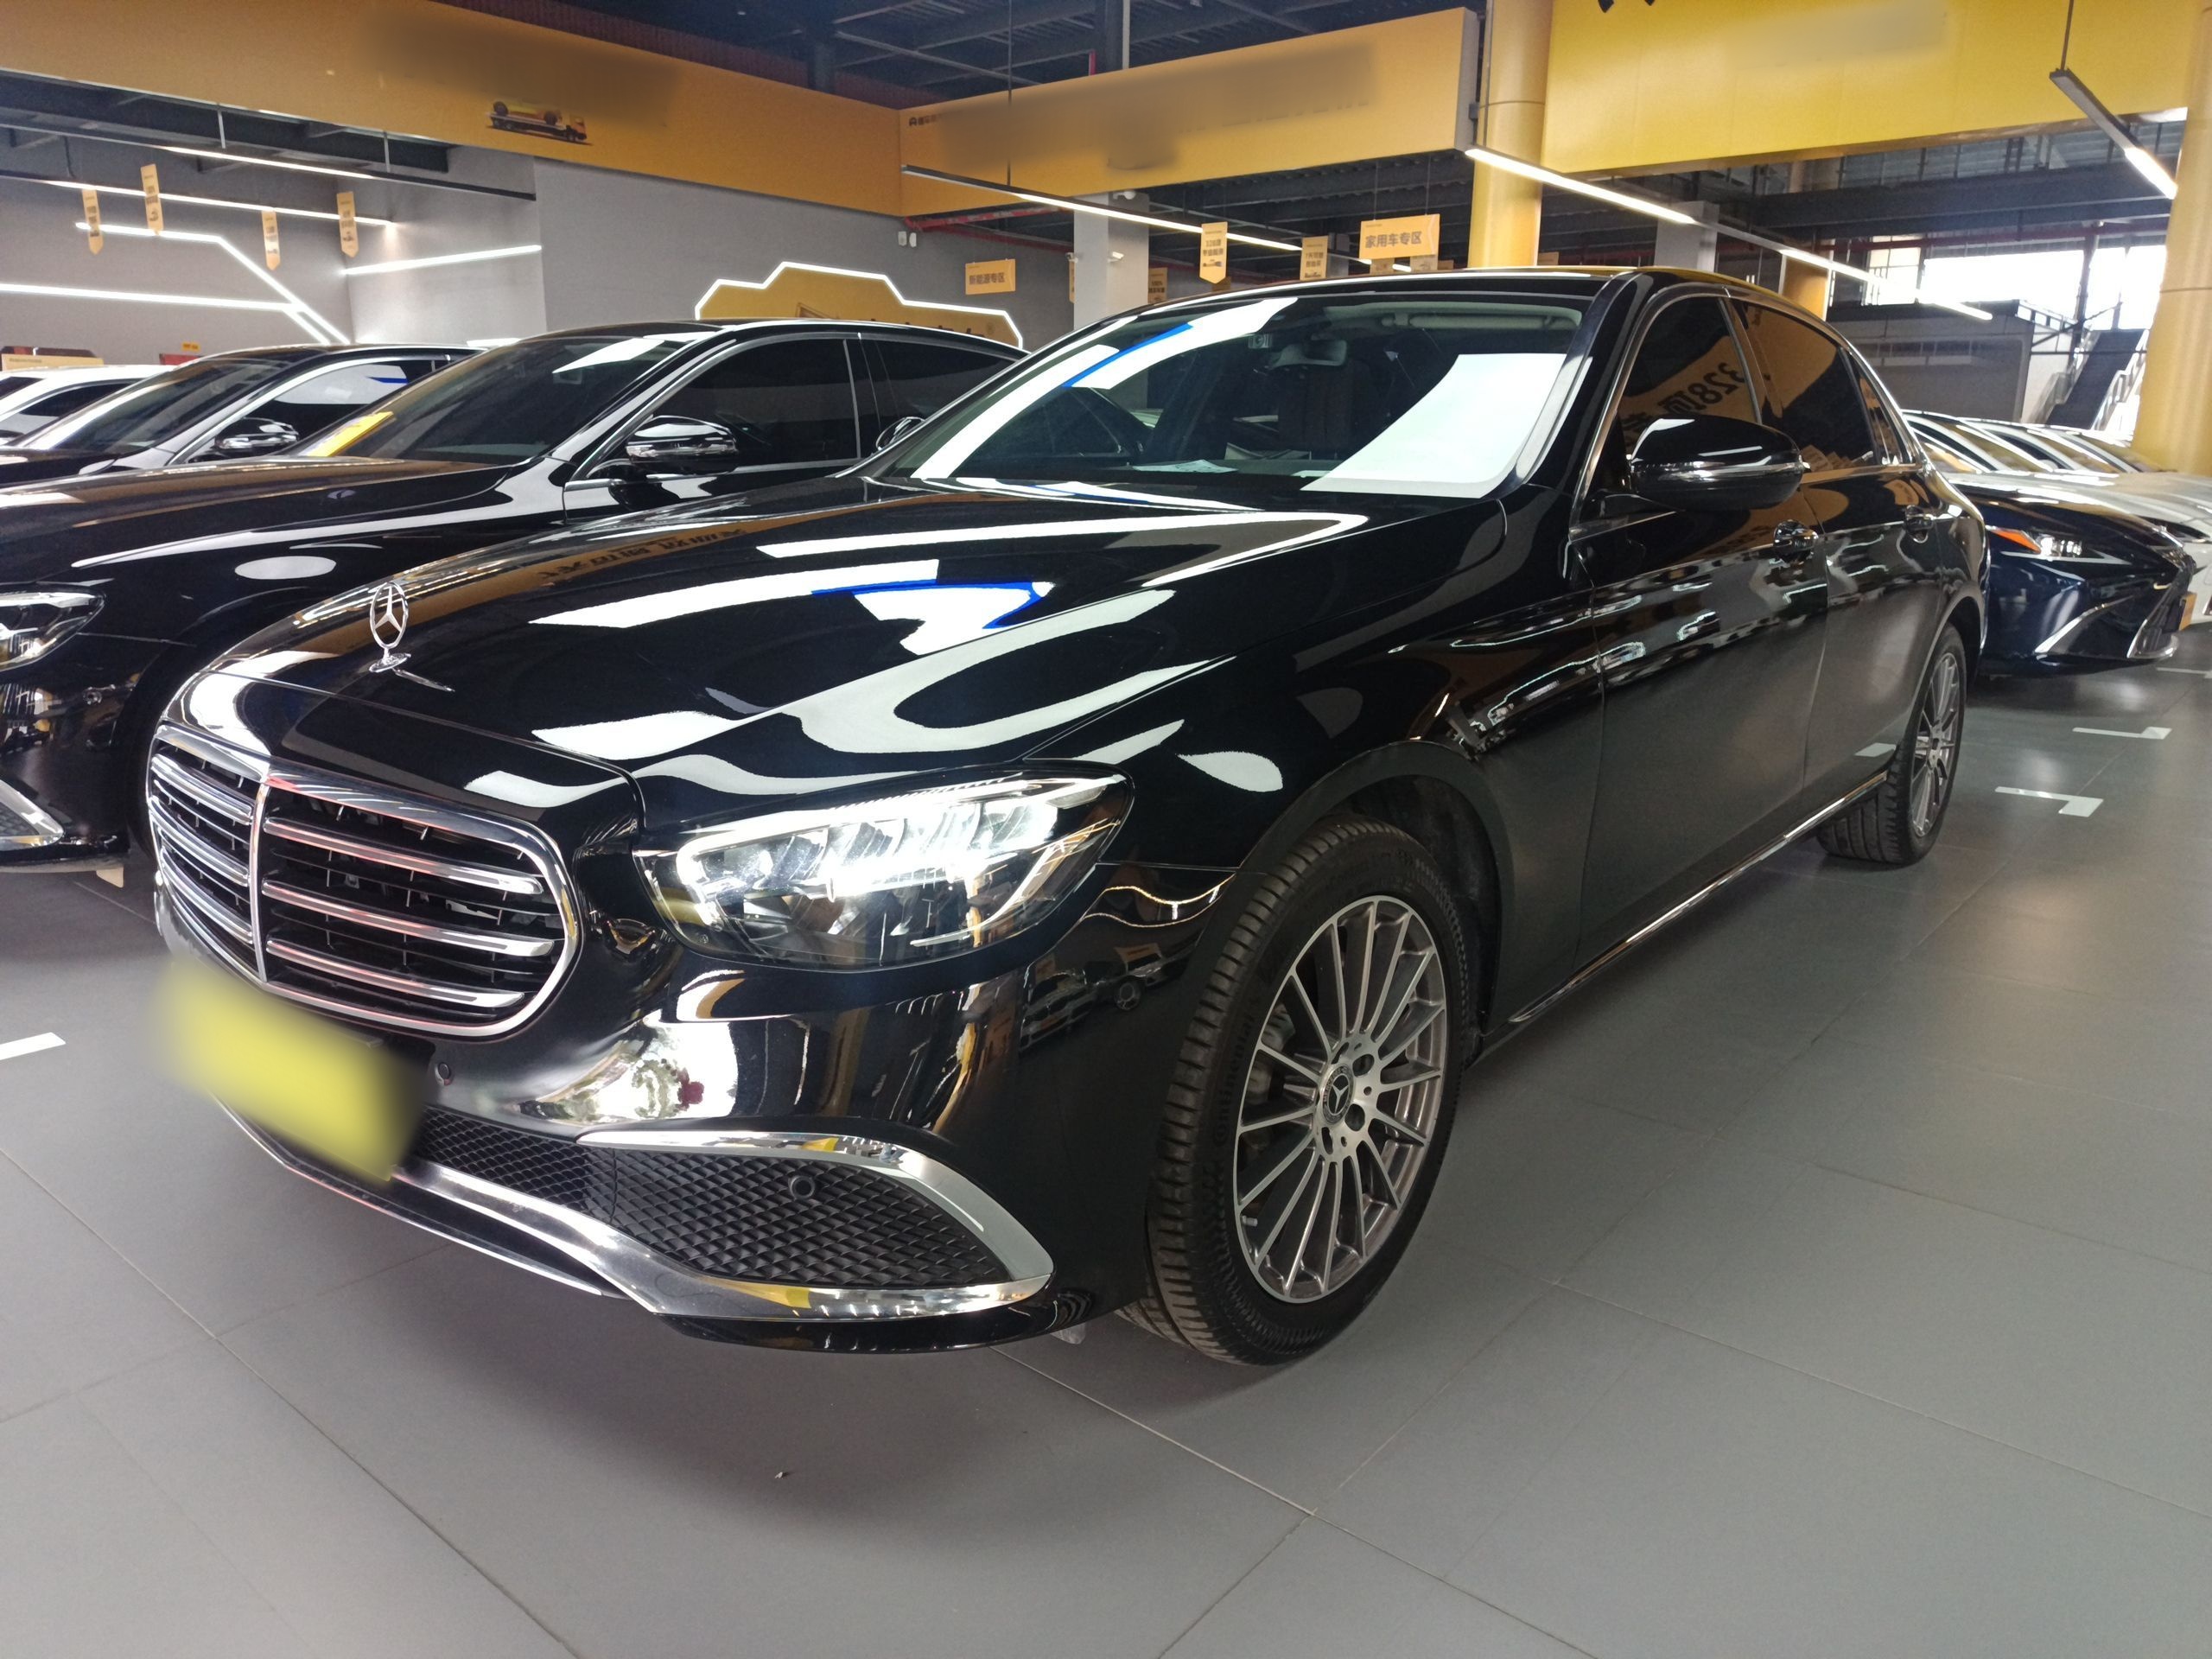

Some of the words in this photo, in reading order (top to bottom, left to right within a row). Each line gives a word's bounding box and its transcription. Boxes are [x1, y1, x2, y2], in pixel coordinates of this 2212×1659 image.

[1365, 231, 1422, 249] 家用车专区
